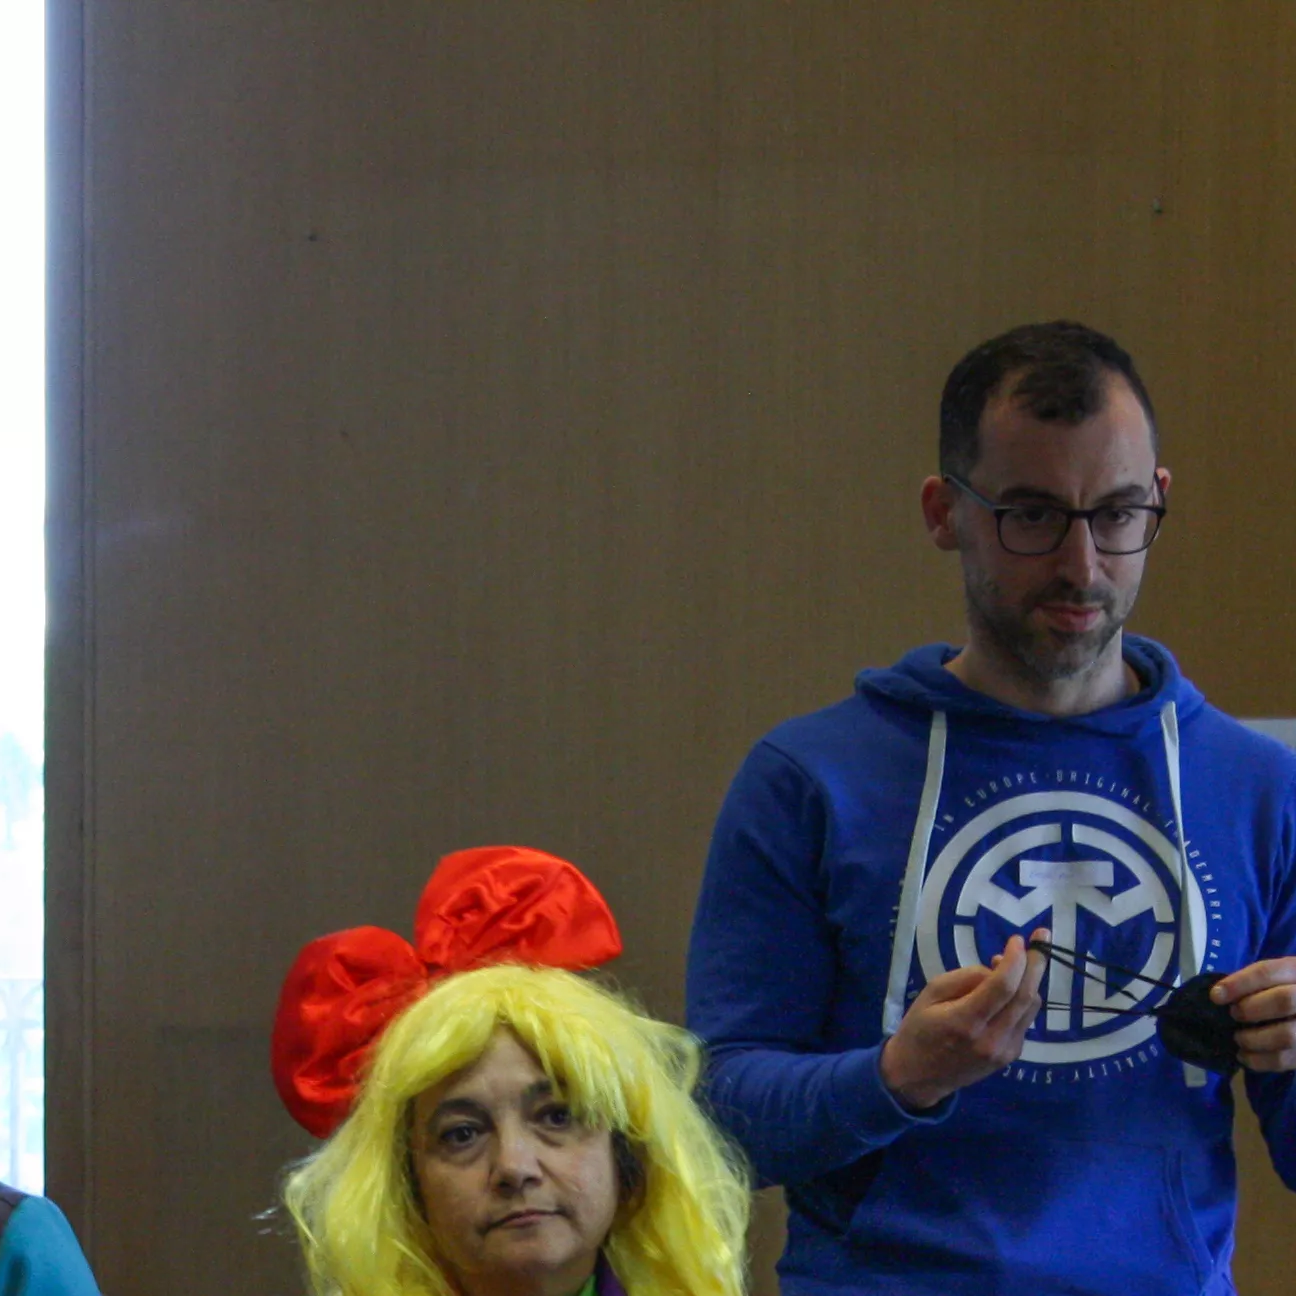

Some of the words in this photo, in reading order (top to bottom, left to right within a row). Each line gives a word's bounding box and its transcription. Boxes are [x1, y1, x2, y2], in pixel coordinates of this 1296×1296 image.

[964, 771, 1037, 808] EUROPE
[1056, 771, 1153, 812] ORIGINAL
[1002, 1063, 1053, 1085] SINC
[1074, 1043, 1159, 1081] QUALITY
